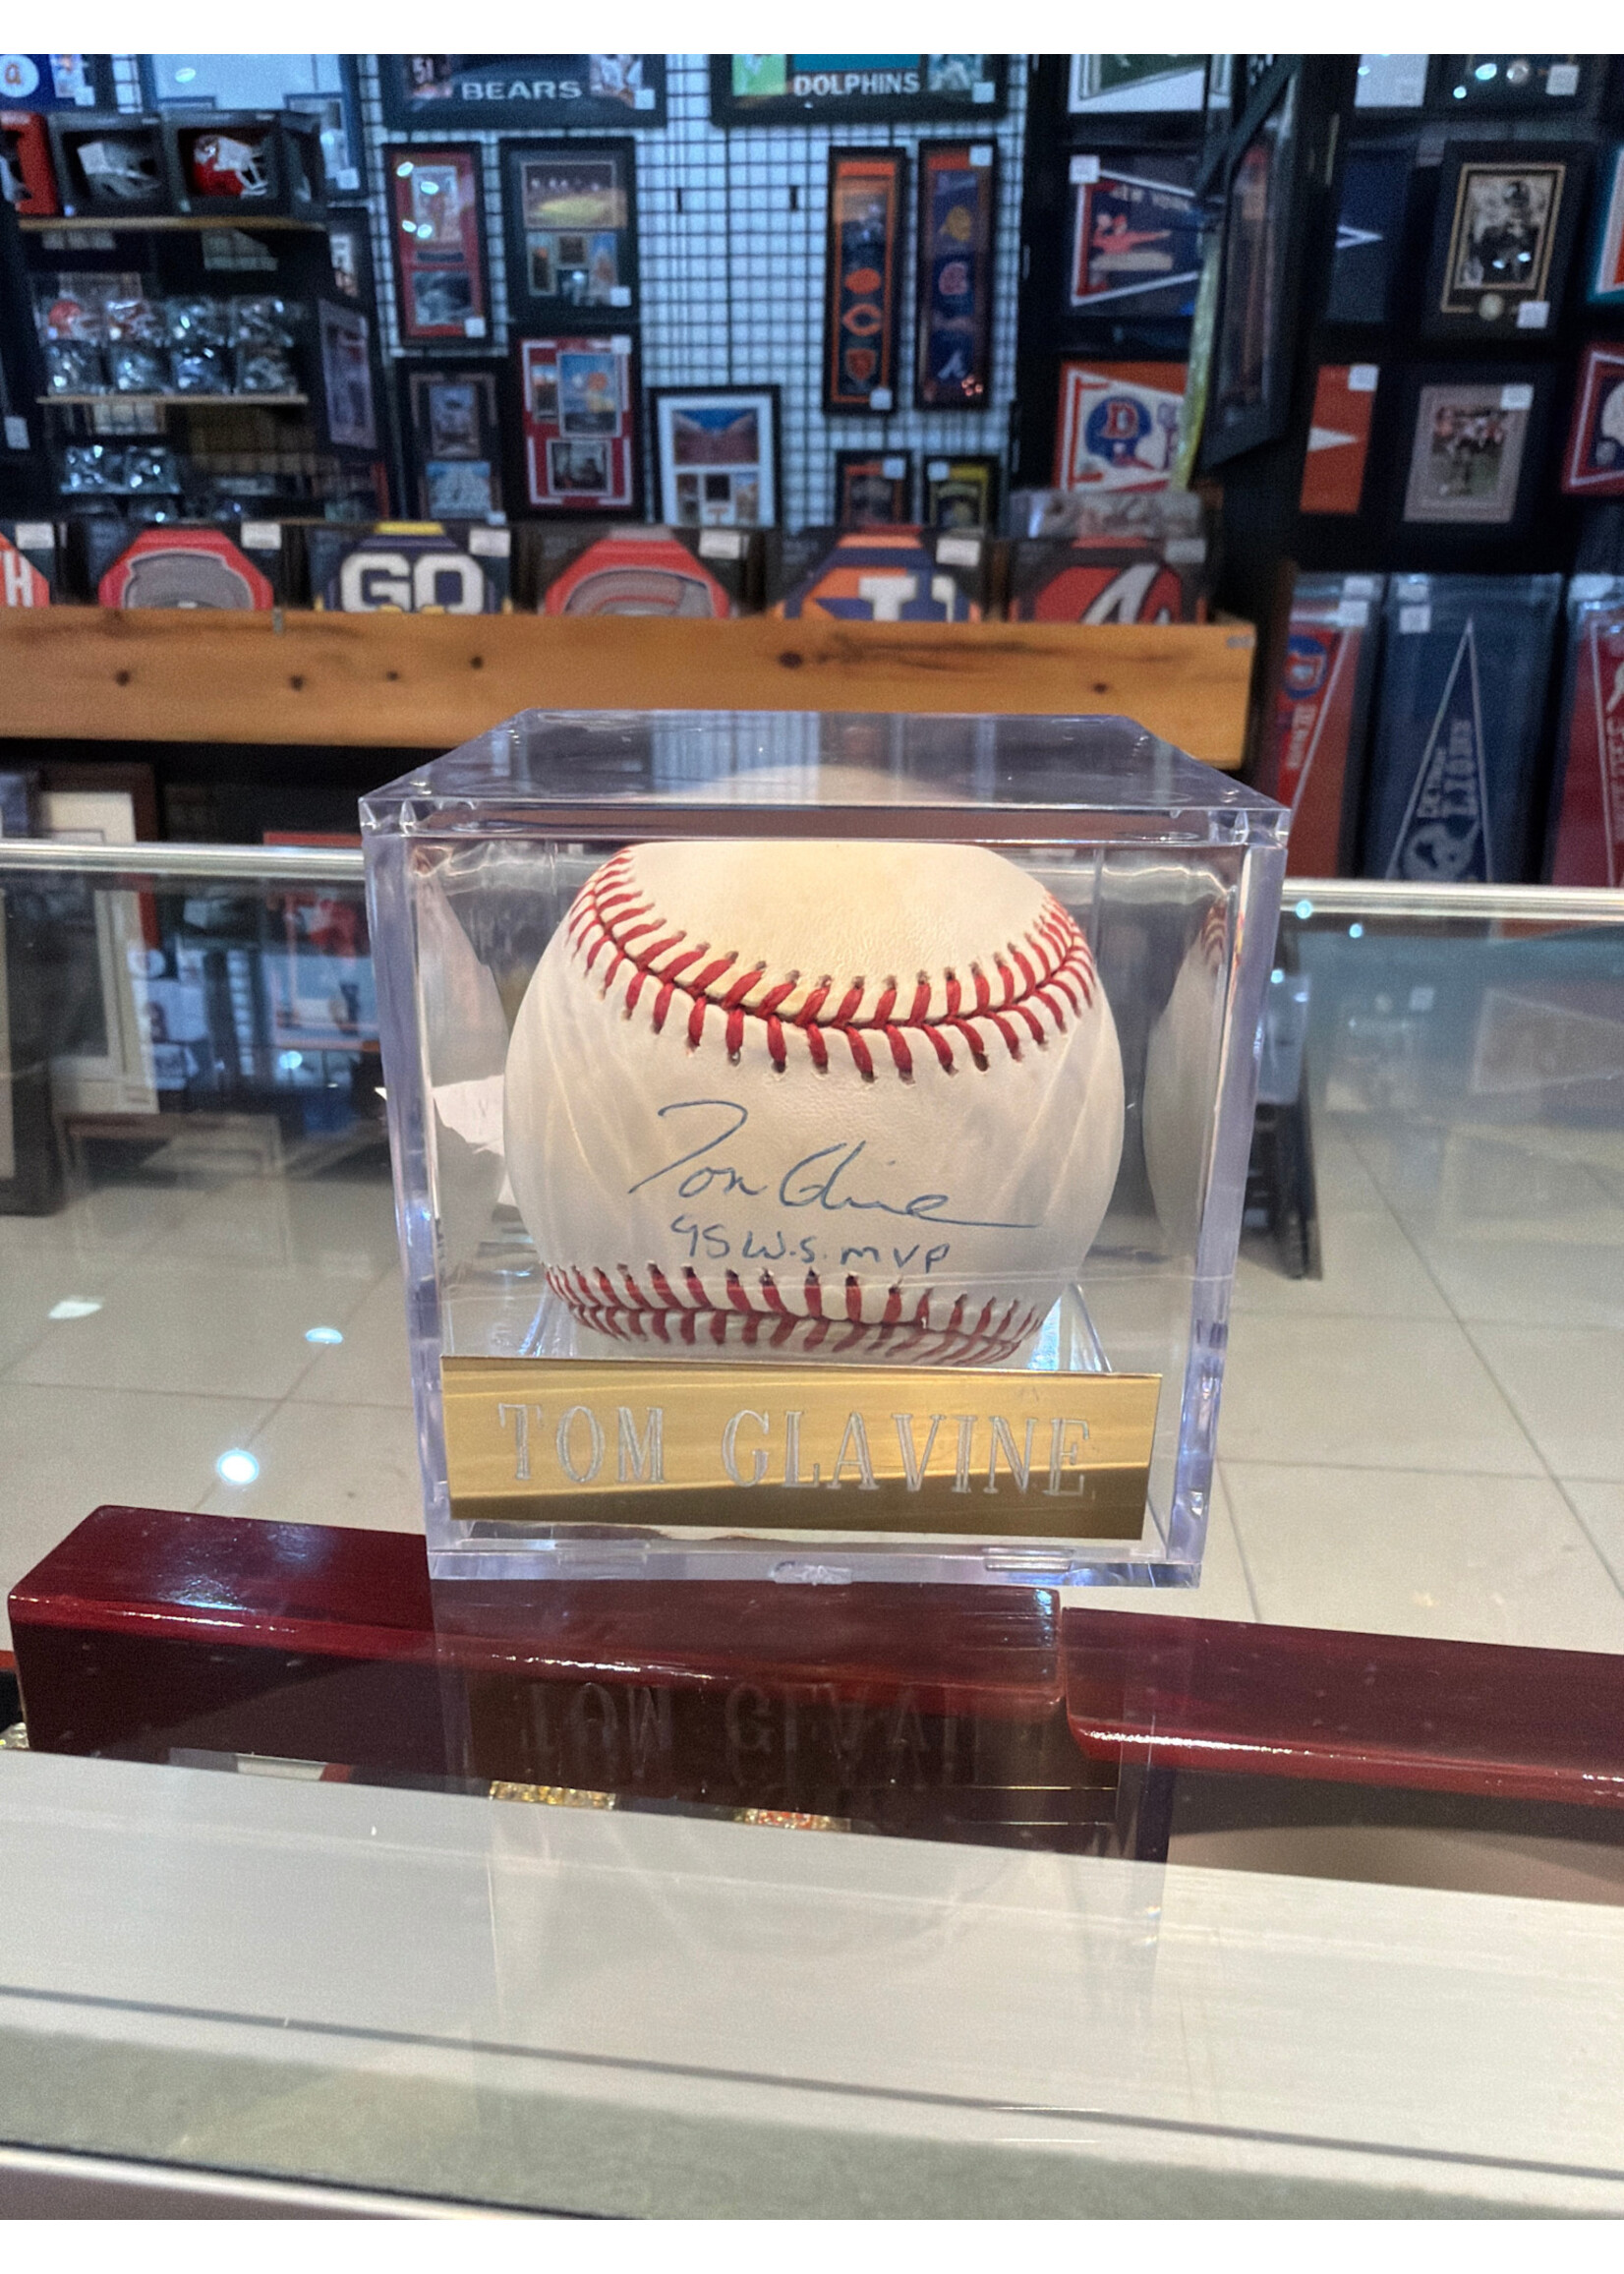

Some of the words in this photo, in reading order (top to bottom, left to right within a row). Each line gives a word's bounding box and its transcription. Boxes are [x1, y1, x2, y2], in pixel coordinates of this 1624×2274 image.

[461, 81, 583, 100] BEARS
[793, 72, 921, 96] DOLPHINS
[341, 553, 485, 613] GO
[497, 1402, 665, 1485] TOM
[722, 1409, 1090, 1497] GLAVINE
